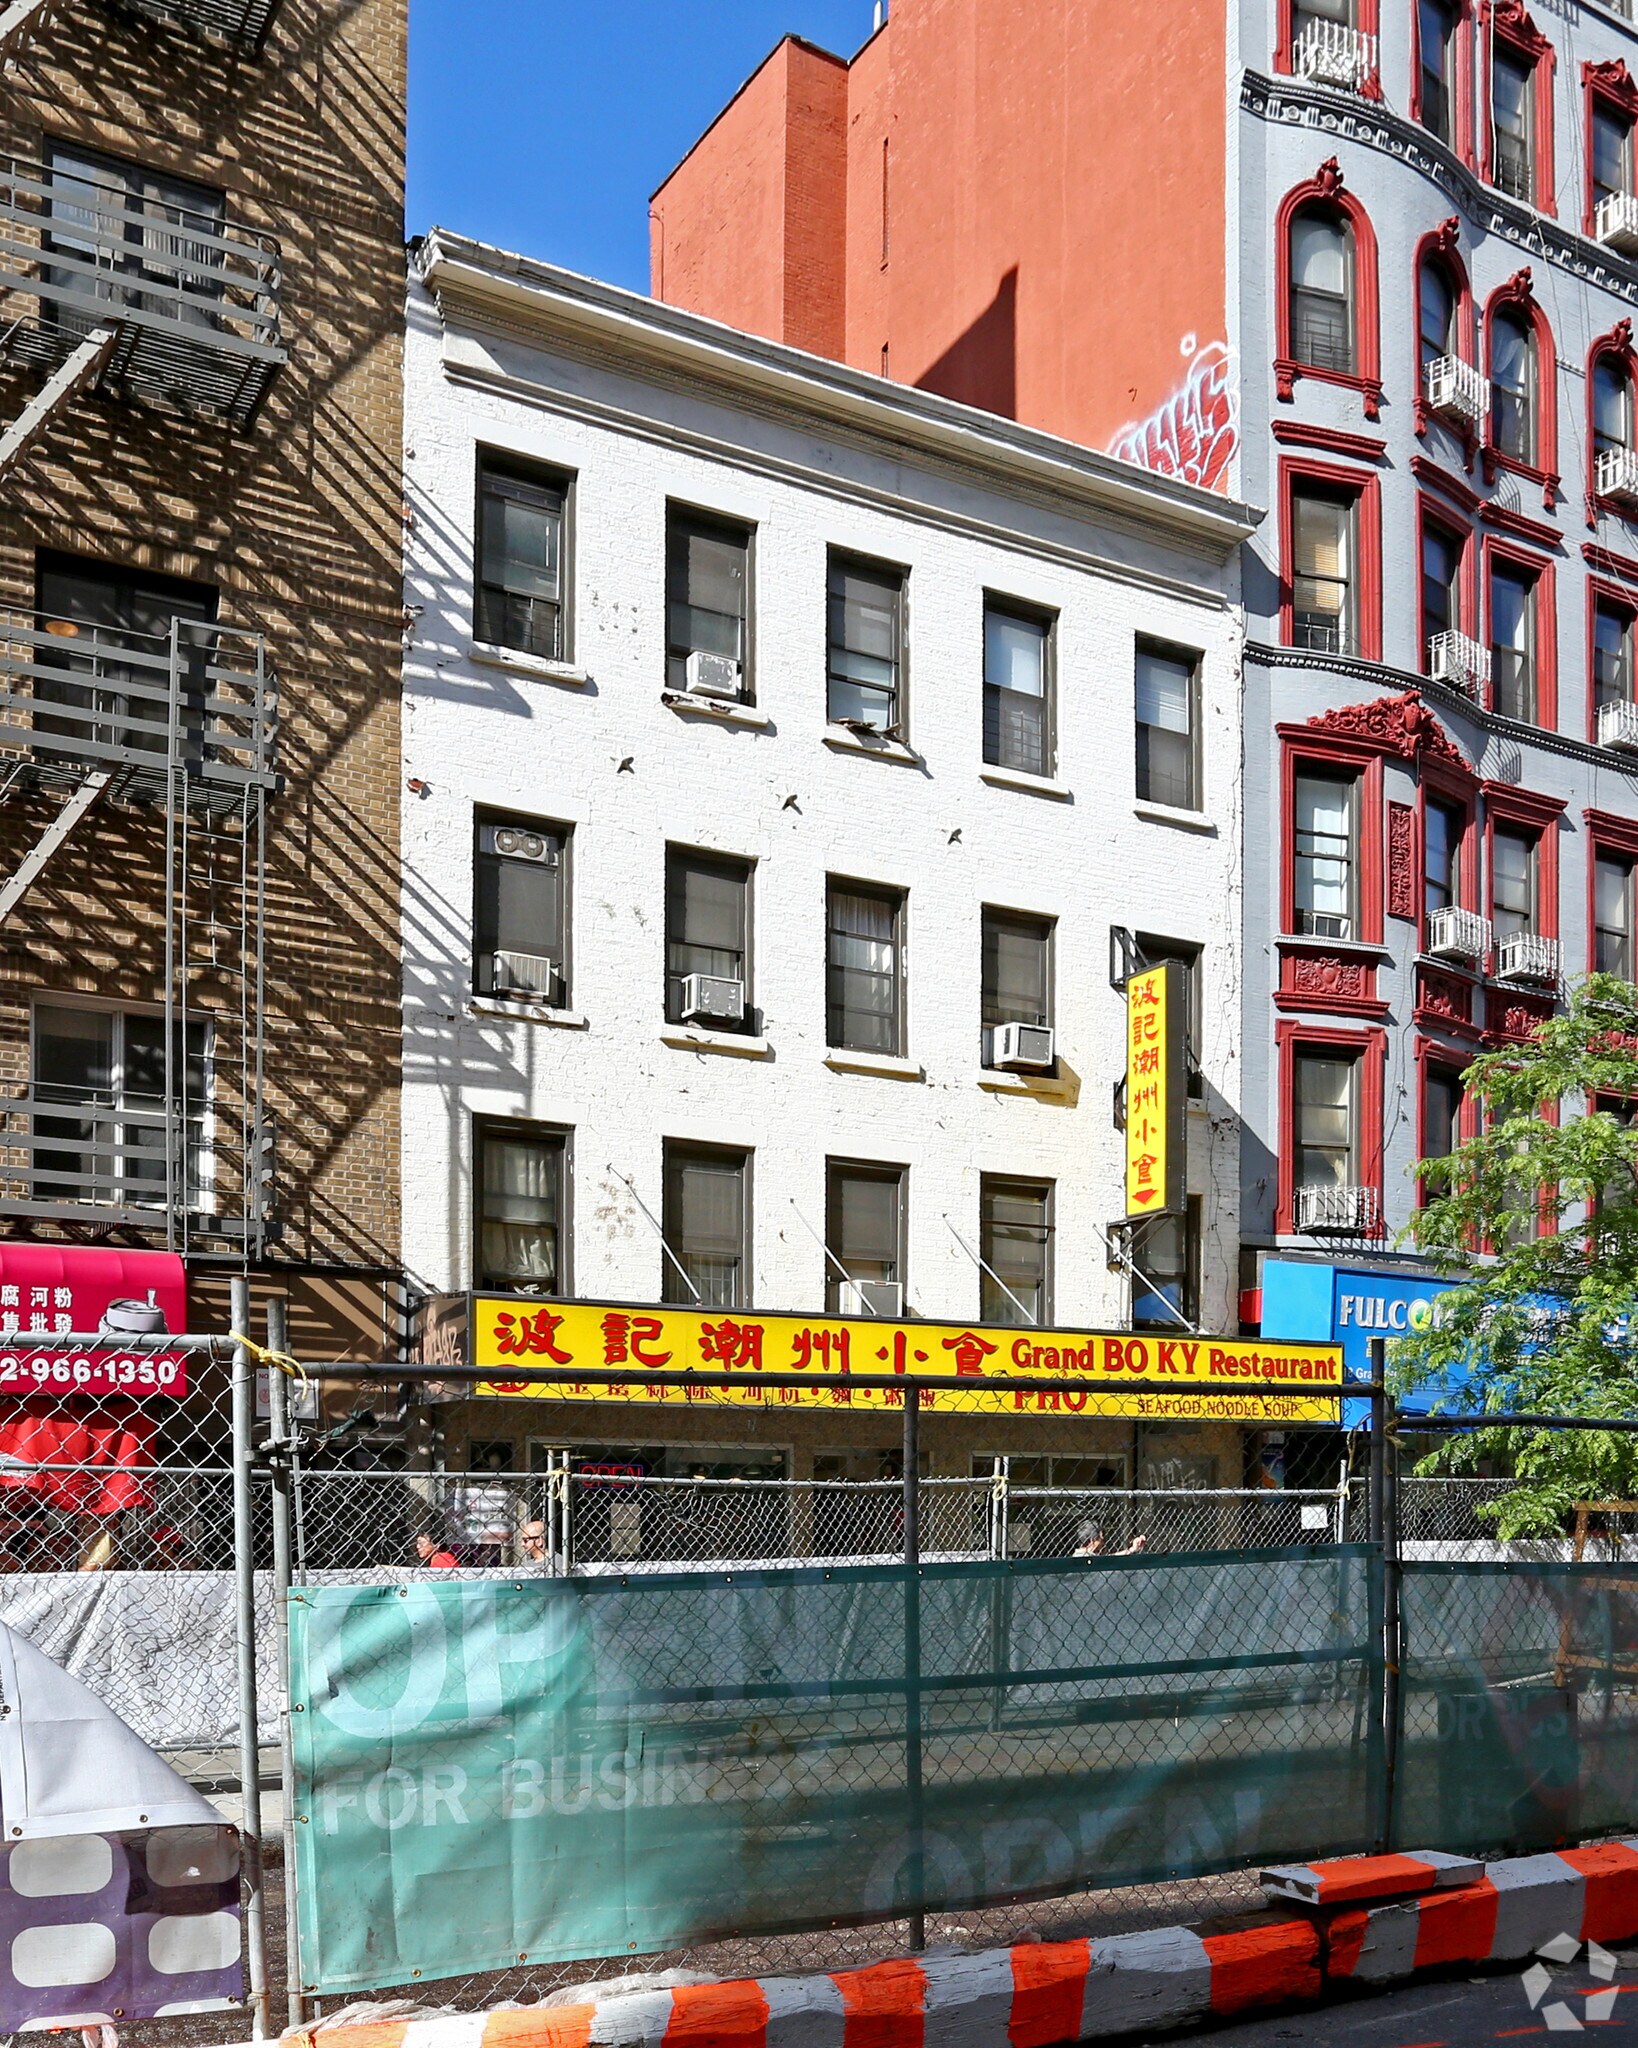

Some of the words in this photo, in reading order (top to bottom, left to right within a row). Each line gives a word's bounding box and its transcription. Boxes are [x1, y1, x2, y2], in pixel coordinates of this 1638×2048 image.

[30, 1286, 73, 1308] 河粉
[0, 1358, 177, 1384] 2-966-1350
[1012, 1339, 1095, 1371] Grand
[1103, 1339, 1149, 1373] BO
[1158, 1342, 1201, 1375] KY
[1209, 1349, 1337, 1381] Restaurant
[1138, 1399, 1200, 1415] SEAFOOD
[1207, 1401, 1259, 1416] NOODLE
[1265, 1403, 1298, 1417] SOUP
[581, 1466, 642, 1487] OPEN
[321, 1764, 470, 1836] FOR
